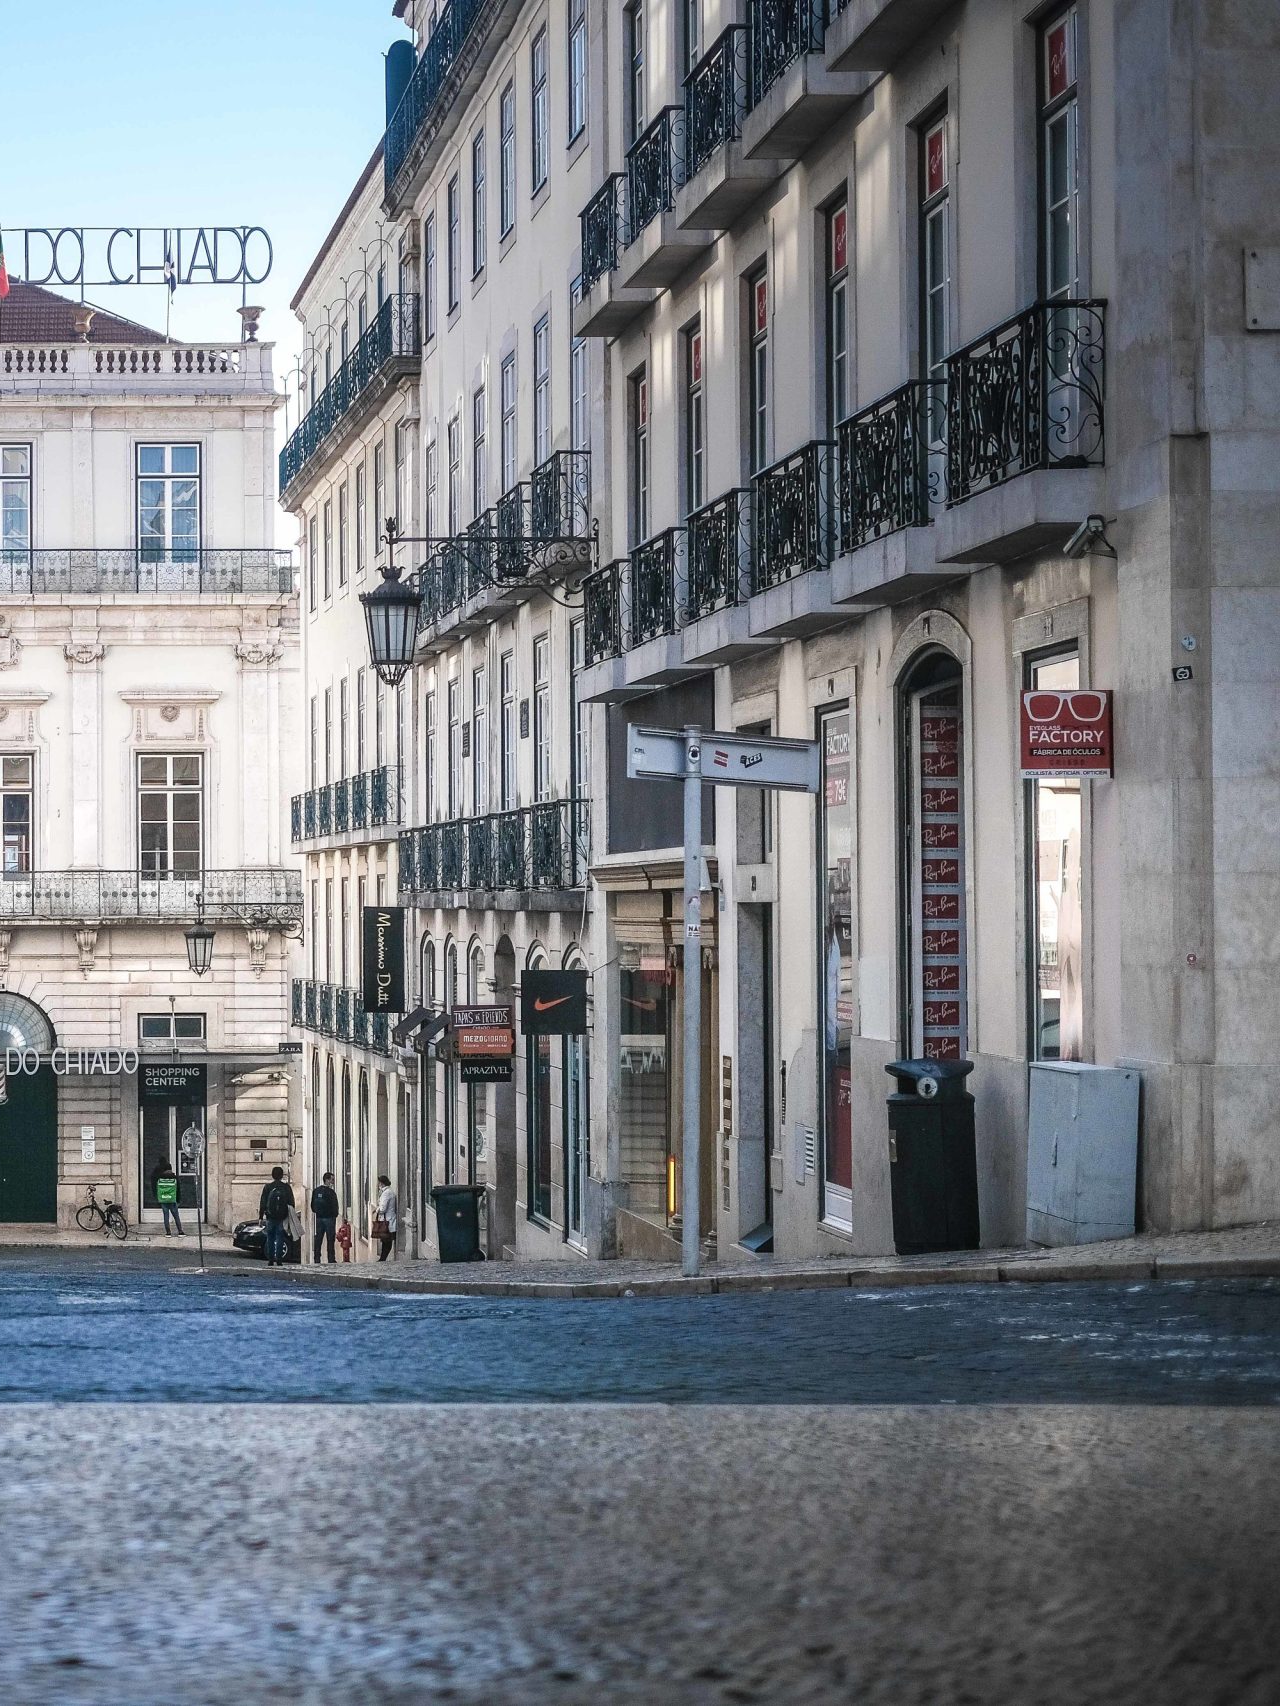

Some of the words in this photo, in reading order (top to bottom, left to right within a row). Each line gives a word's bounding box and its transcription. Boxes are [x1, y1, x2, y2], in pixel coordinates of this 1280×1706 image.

[24, 227, 85, 285] DO
[107, 226, 273, 285] CHIADO
[922, 718, 954, 738] Ray-Ban
[1029, 730, 1104, 743] FACTORY
[826, 733, 849, 755] FACTOR
[1033, 748, 1062, 756] FÁBRICA
[1072, 748, 1101, 756] ÓCULOS
[923, 754, 955, 774] Ray-Ban
[923, 789, 955, 810] Ray-Ban
[922, 825, 955, 845] Ray-Ban
[922, 860, 956, 880] Ray-Ban
[923, 895, 956, 916] Ray-Ban
[376, 912, 391, 969] Massimo
[923, 931, 956, 952] Ray-Ban
[923, 966, 956, 987] Ray-Ban
[376, 972, 391, 1007] Dutti
[454, 1012, 473, 1024] TAPAS
[482, 1010, 508, 1023] FRIENDS
[924, 1002, 956, 1023] Ray-Ban
[924, 1038, 957, 1058] Ray-Ban
[5, 1047, 40, 1076] DO
[51, 1047, 140, 1076] CHIADO
[462, 1065, 509, 1075] APRAZÍVEL
[145, 1067, 200, 1077] SHOPPING
[145, 1077, 186, 1086] CENTER
